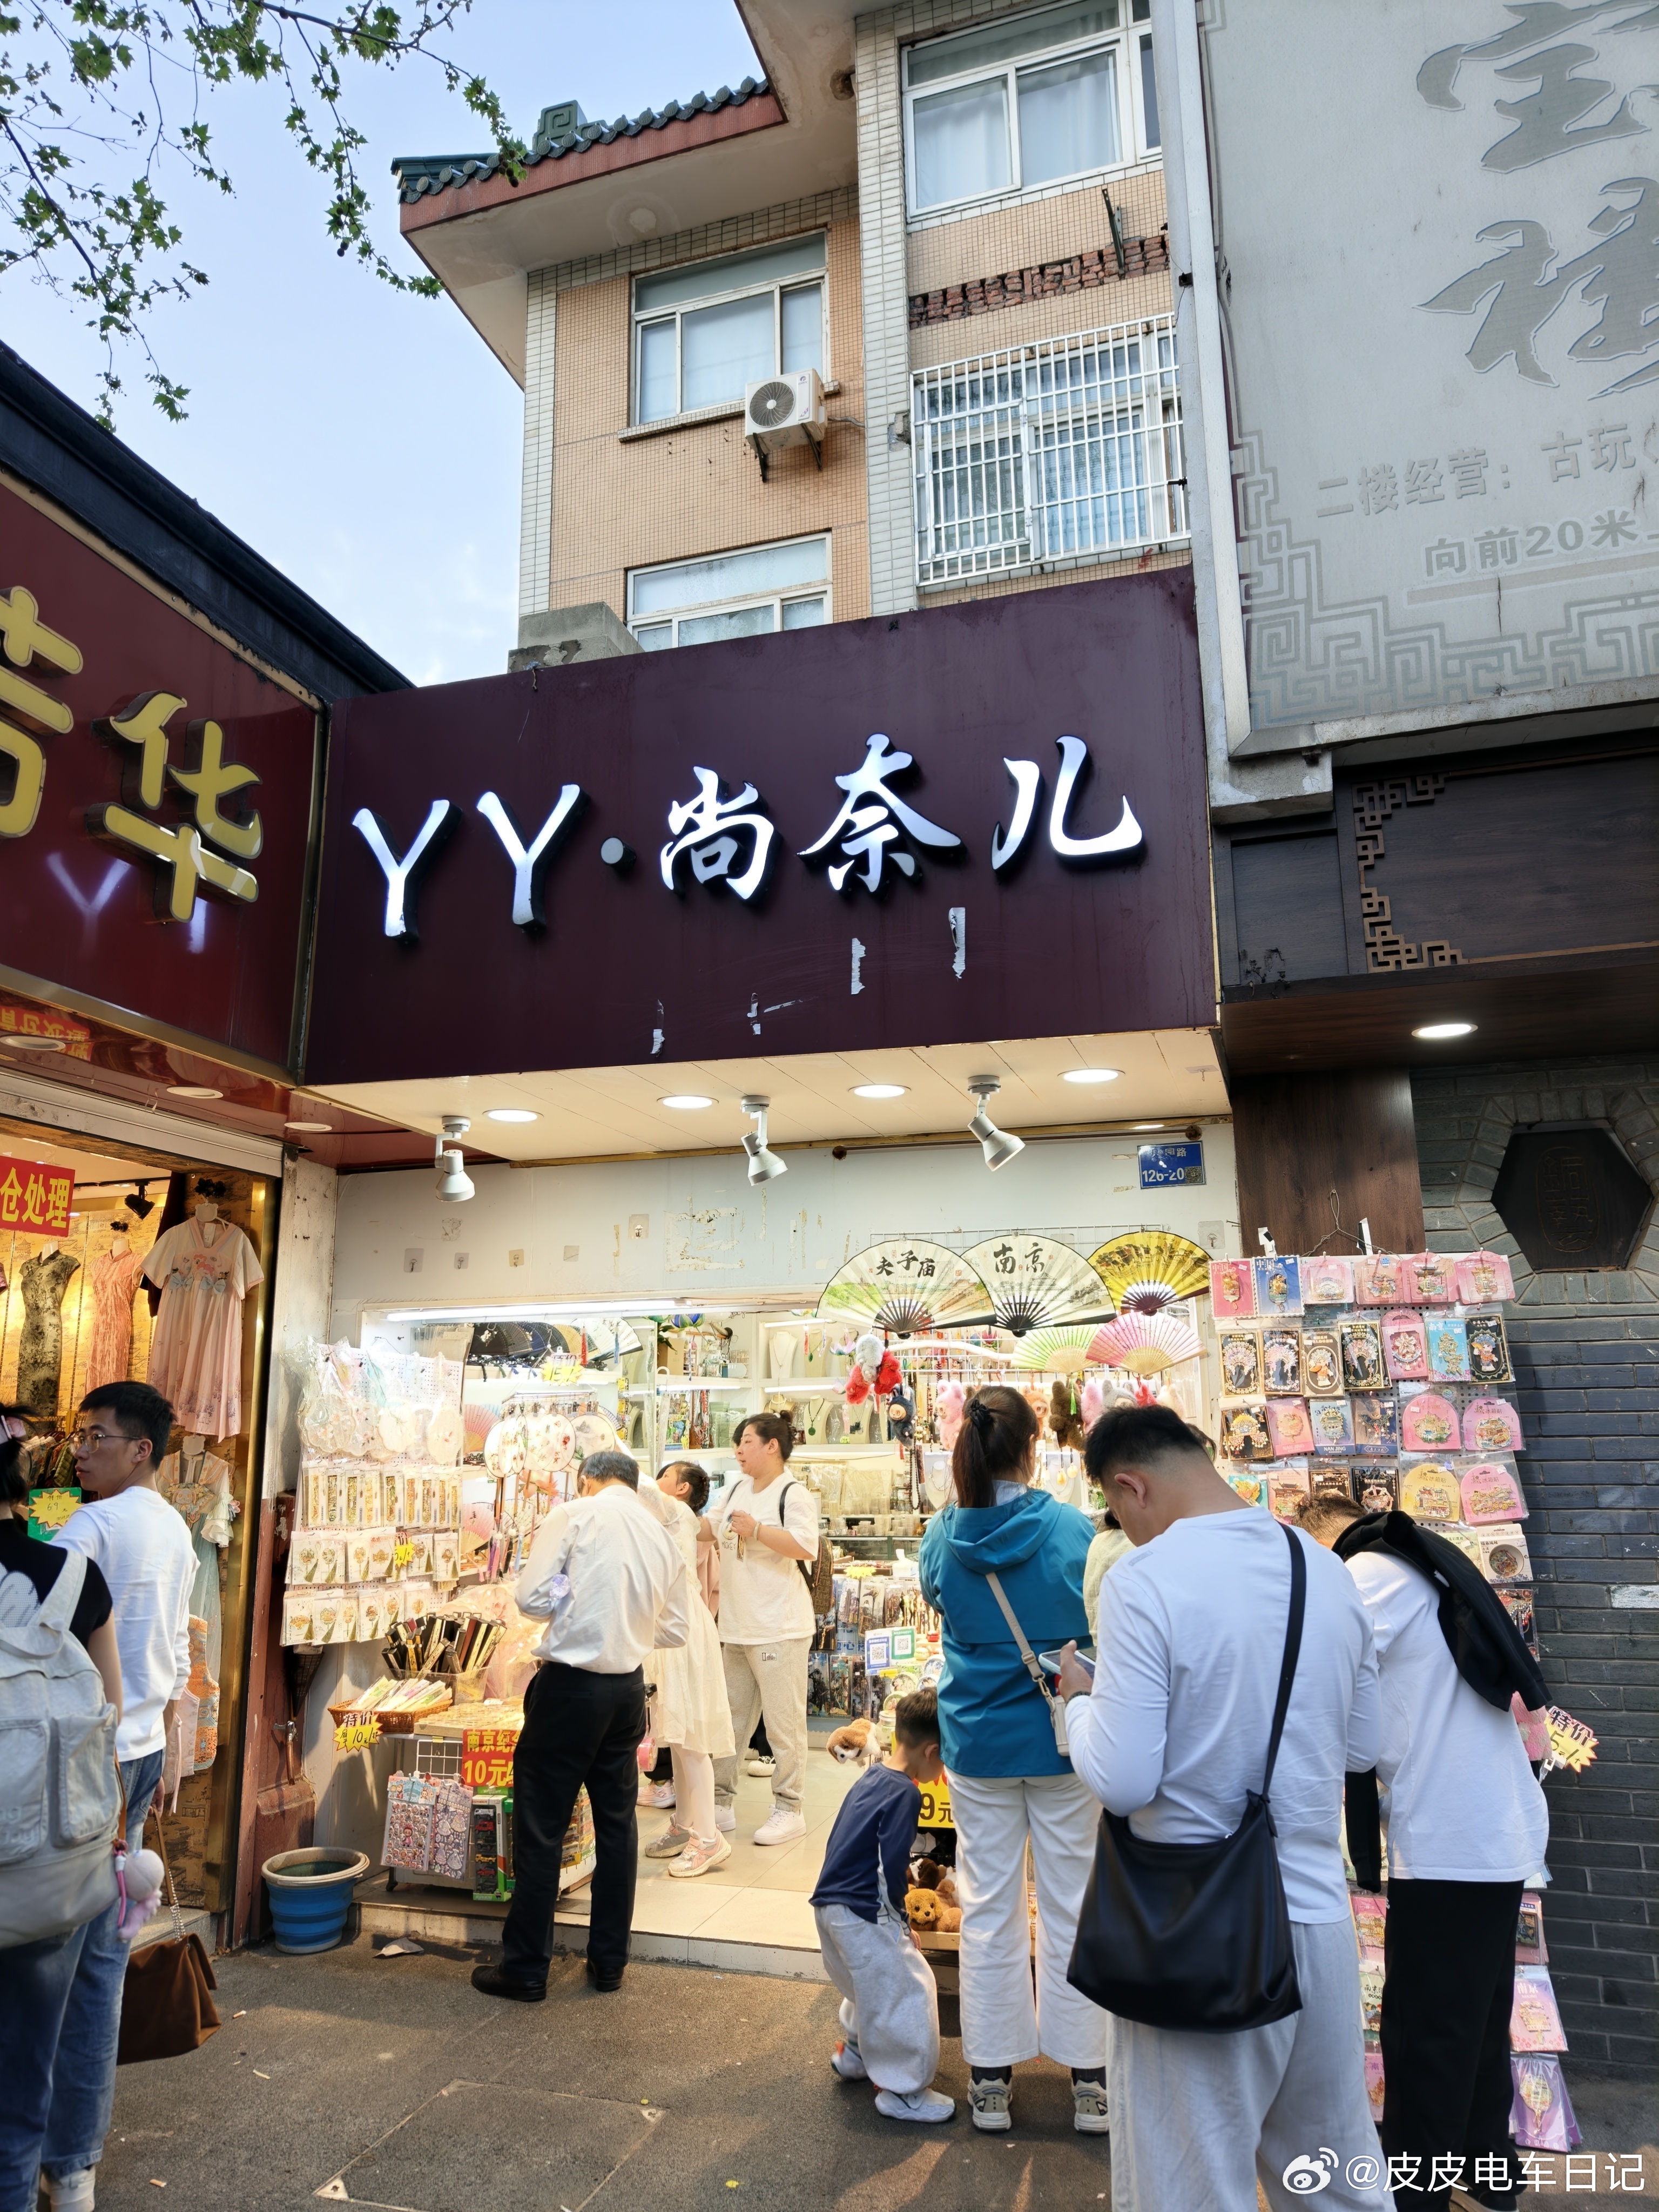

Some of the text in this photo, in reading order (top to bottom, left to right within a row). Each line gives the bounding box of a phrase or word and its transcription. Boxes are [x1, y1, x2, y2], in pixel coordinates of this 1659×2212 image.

[1316, 447, 1510, 518] 二楼经营：
[1142, 1168, 1185, 1182] 126-20
[0, 1166, 70, 1229] 仓处理
[876, 1250, 936, 1278] 夫子庙
[993, 1242, 1045, 1274] 南京
[47, 1502, 58, 1510] 69
[344, 1710, 373, 1728] 特价
[1549, 1709, 1591, 1746] 特价
[464, 1759, 508, 1786] 10元
